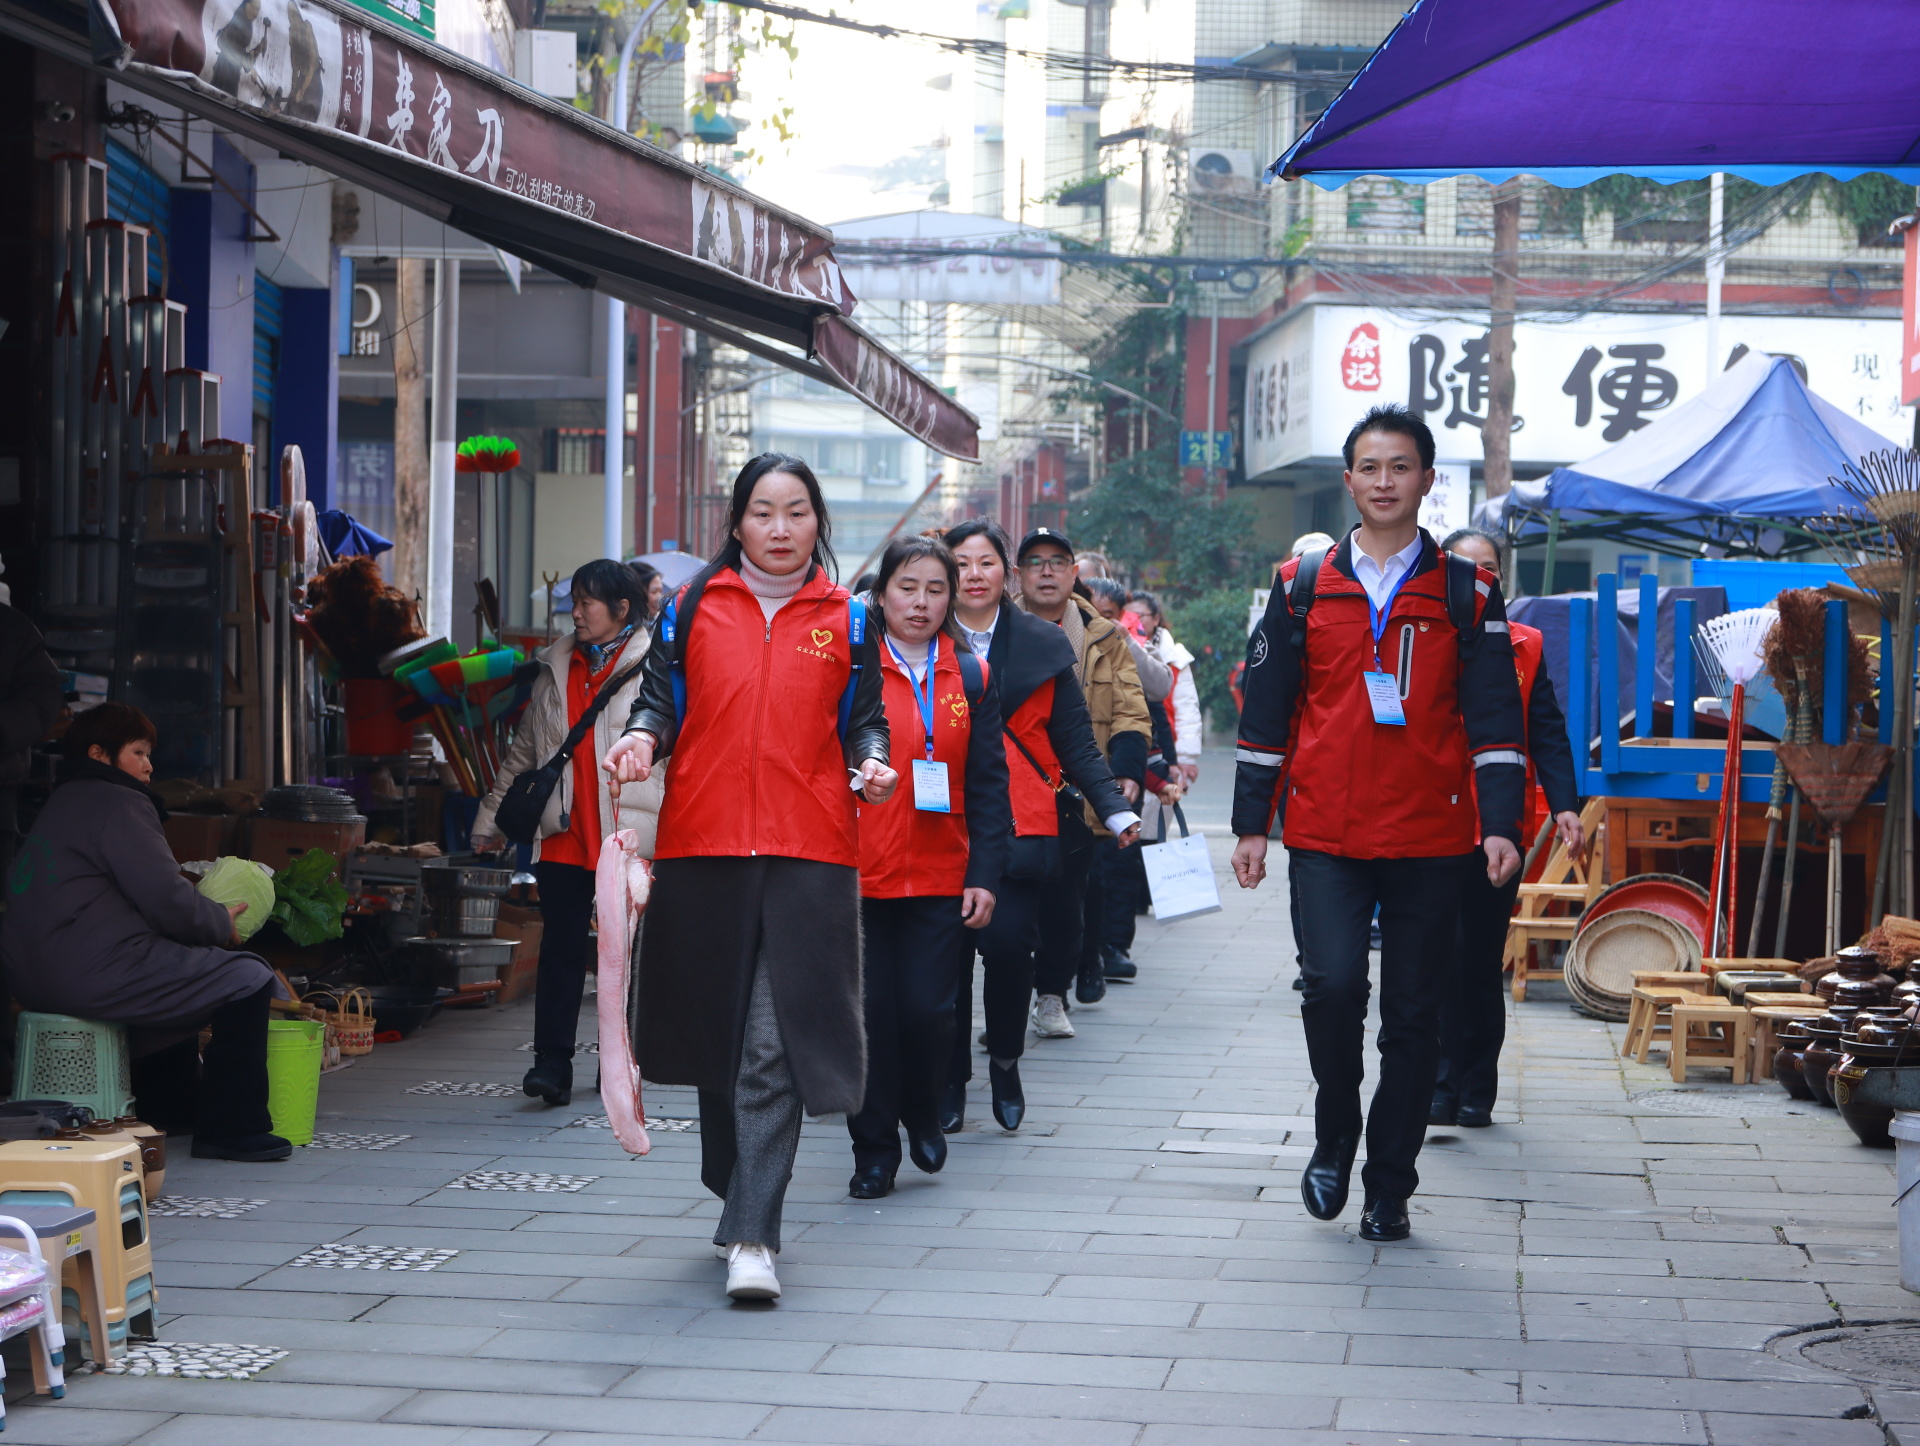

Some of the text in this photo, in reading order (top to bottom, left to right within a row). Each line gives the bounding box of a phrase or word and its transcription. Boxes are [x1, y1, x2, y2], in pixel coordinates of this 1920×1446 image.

[506, 167, 596, 220] 可以刮胡子的菜刀
[1346, 331, 1380, 386] 余记
